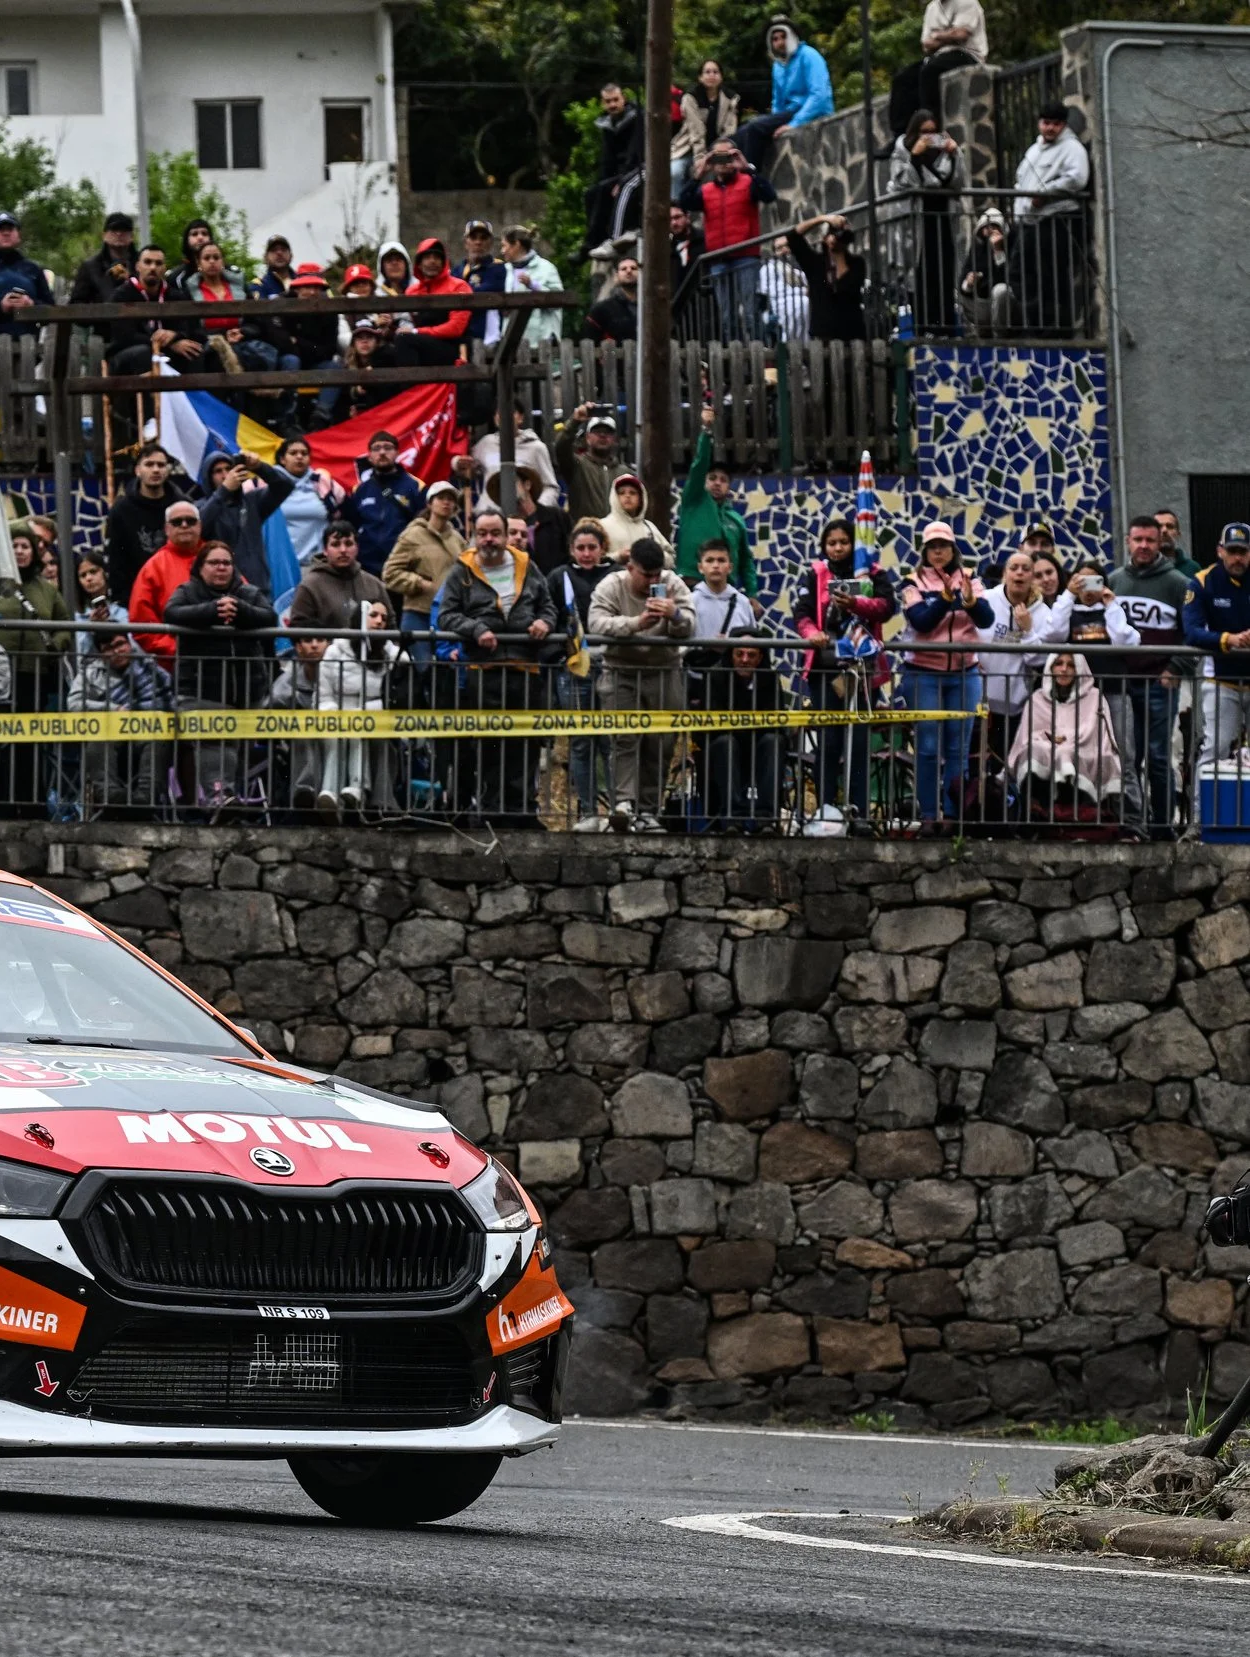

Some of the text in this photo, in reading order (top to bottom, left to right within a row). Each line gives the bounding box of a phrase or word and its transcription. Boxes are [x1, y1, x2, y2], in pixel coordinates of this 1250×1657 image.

[30, 719, 100, 736] PUBLICO
[119, 717, 237, 735] ZONA PUBLICO
[255, 716, 376, 733] ZONA PUBLICO
[394, 715, 514, 732] ZONA PUBLICO
[532, 713, 651, 730] ZONA PUBLICO
[671, 713, 789, 728] ZONA PUBLICO
[116, 1114, 371, 1153] MOTUL
[262, 1306, 325, 1319] NR S 109
